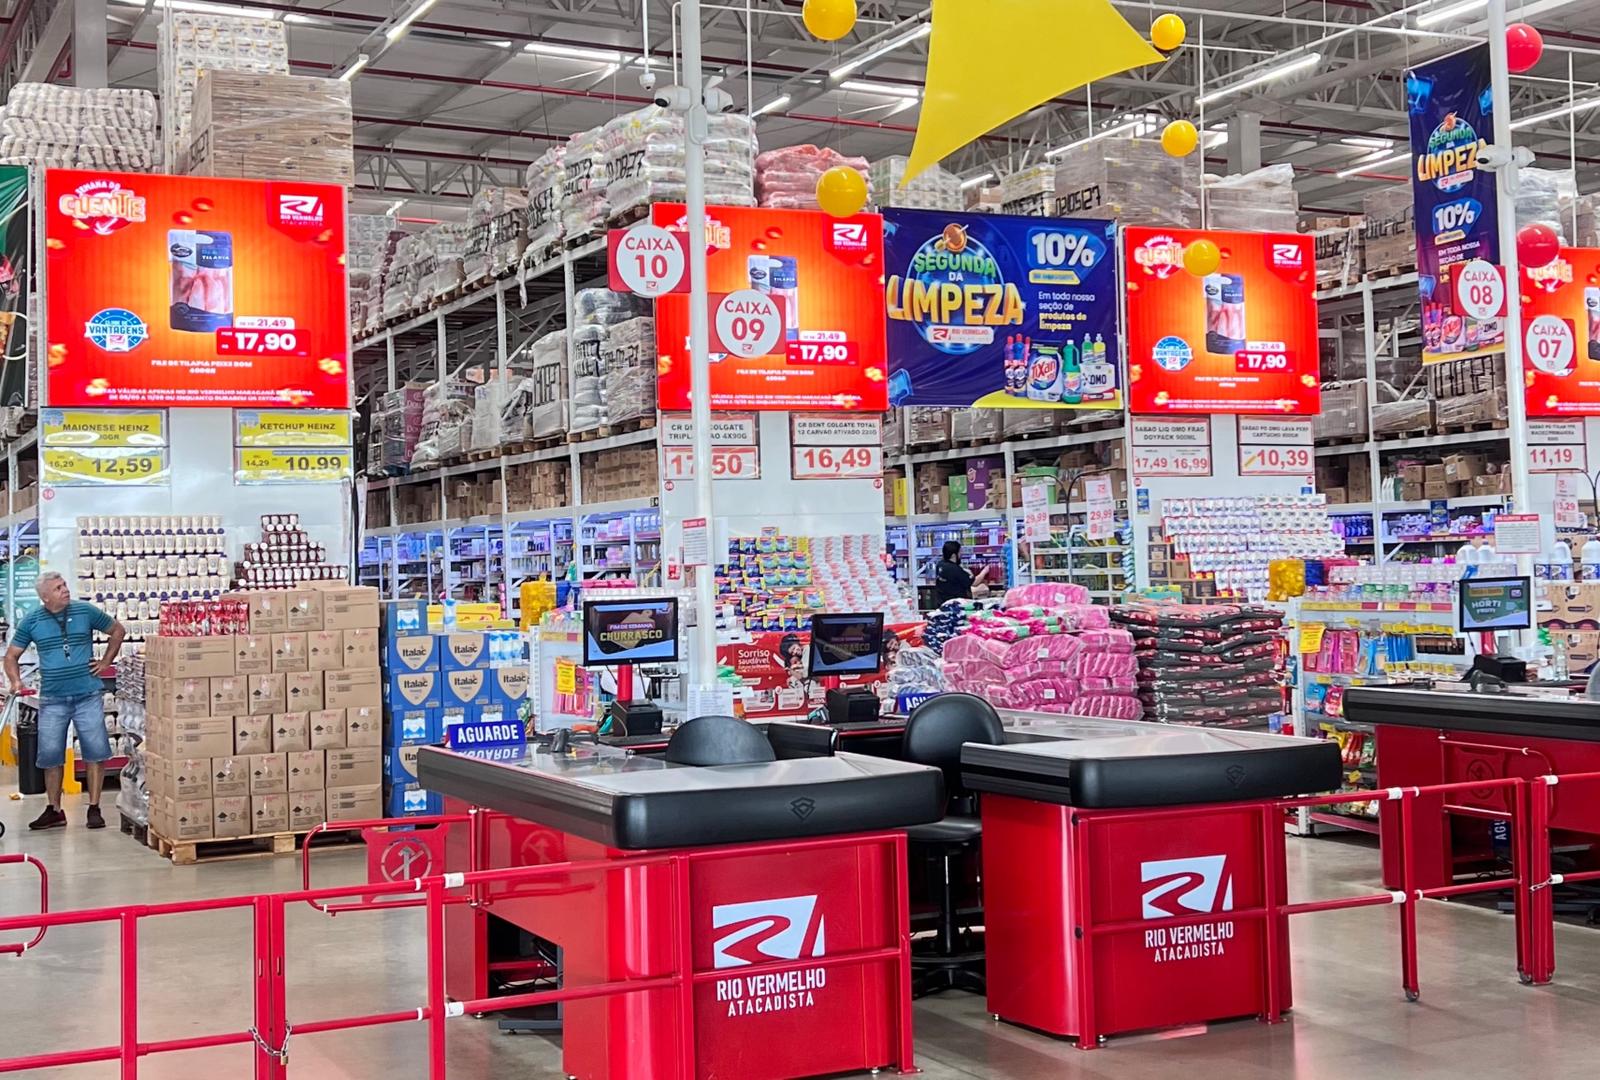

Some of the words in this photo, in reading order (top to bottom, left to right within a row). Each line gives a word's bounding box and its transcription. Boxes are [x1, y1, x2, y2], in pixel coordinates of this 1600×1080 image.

[1429, 125, 1472, 148] SEGUNDA
[75, 181, 107, 196] SEMANA
[109, 180, 121, 191] DO
[59, 189, 146, 222] CLIENTE
[1435, 201, 1475, 231] 10%
[625, 237, 674, 252] CAIXA
[1032, 232, 1096, 267] 10%
[635, 255, 668, 279] 10
[914, 252, 996, 278] SEGUNDA
[948, 271, 964, 282] DA
[1464, 270, 1496, 283] CAIXA
[886, 275, 1024, 326] LIMPEZA
[1038, 291, 1051, 300] Em
[1072, 294, 1095, 302] nossa
[1470, 285, 1493, 305] 08
[724, 300, 771, 315] CAIXA
[1063, 303, 1074, 311] de
[257, 318, 286, 327] 21,49
[1039, 312, 1075, 320] produtos
[88, 325, 144, 335] VANTAGENS
[731, 317, 765, 341] 09
[1039, 321, 1072, 332] limpeza
[1532, 325, 1567, 337] CAIXA
[235, 332, 296, 352] 17,90
[1537, 338, 1562, 359] 07
[800, 345, 848, 361] 17,90
[1247, 354, 1286, 370] 17,90
[1089, 373, 1107, 385] OMO
[62, 424, 117, 432] MAIONESE
[119, 424, 149, 432] HEINZ
[803, 449, 871, 472] 16,49
[1135, 458, 1168, 469] 17,49
[1174, 458, 1207, 470] 16,99
[1258, 449, 1308, 470] 10,39
[1530, 448, 1572, 465] 11,19
[49, 460, 74, 468] 16,29
[91, 458, 152, 476] 12,59
[1026, 512, 1047, 524] 29,99
[1090, 509, 1112, 521] 29,99
[1472, 600, 1502, 609] HORTI
[600, 630, 663, 642] CHURRASCO
[402, 646, 427, 657] Italac
[454, 644, 478, 654] Italac
[738, 649, 770, 658] Sorriso
[738, 657, 769, 665] saudável
[404, 678, 428, 689] Italac
[454, 676, 478, 686] Italac
[503, 674, 527, 684] Italac
[458, 724, 519, 744] AGUARDE
[1144, 928, 1166, 949] RIO
[1169, 921, 1234, 945] VERMELHO
[1154, 941, 1225, 963] ATACADISTA
[716, 977, 743, 1001] RIO
[746, 967, 826, 997] VERMELHO
[728, 991, 814, 1017] ATACADISTA
